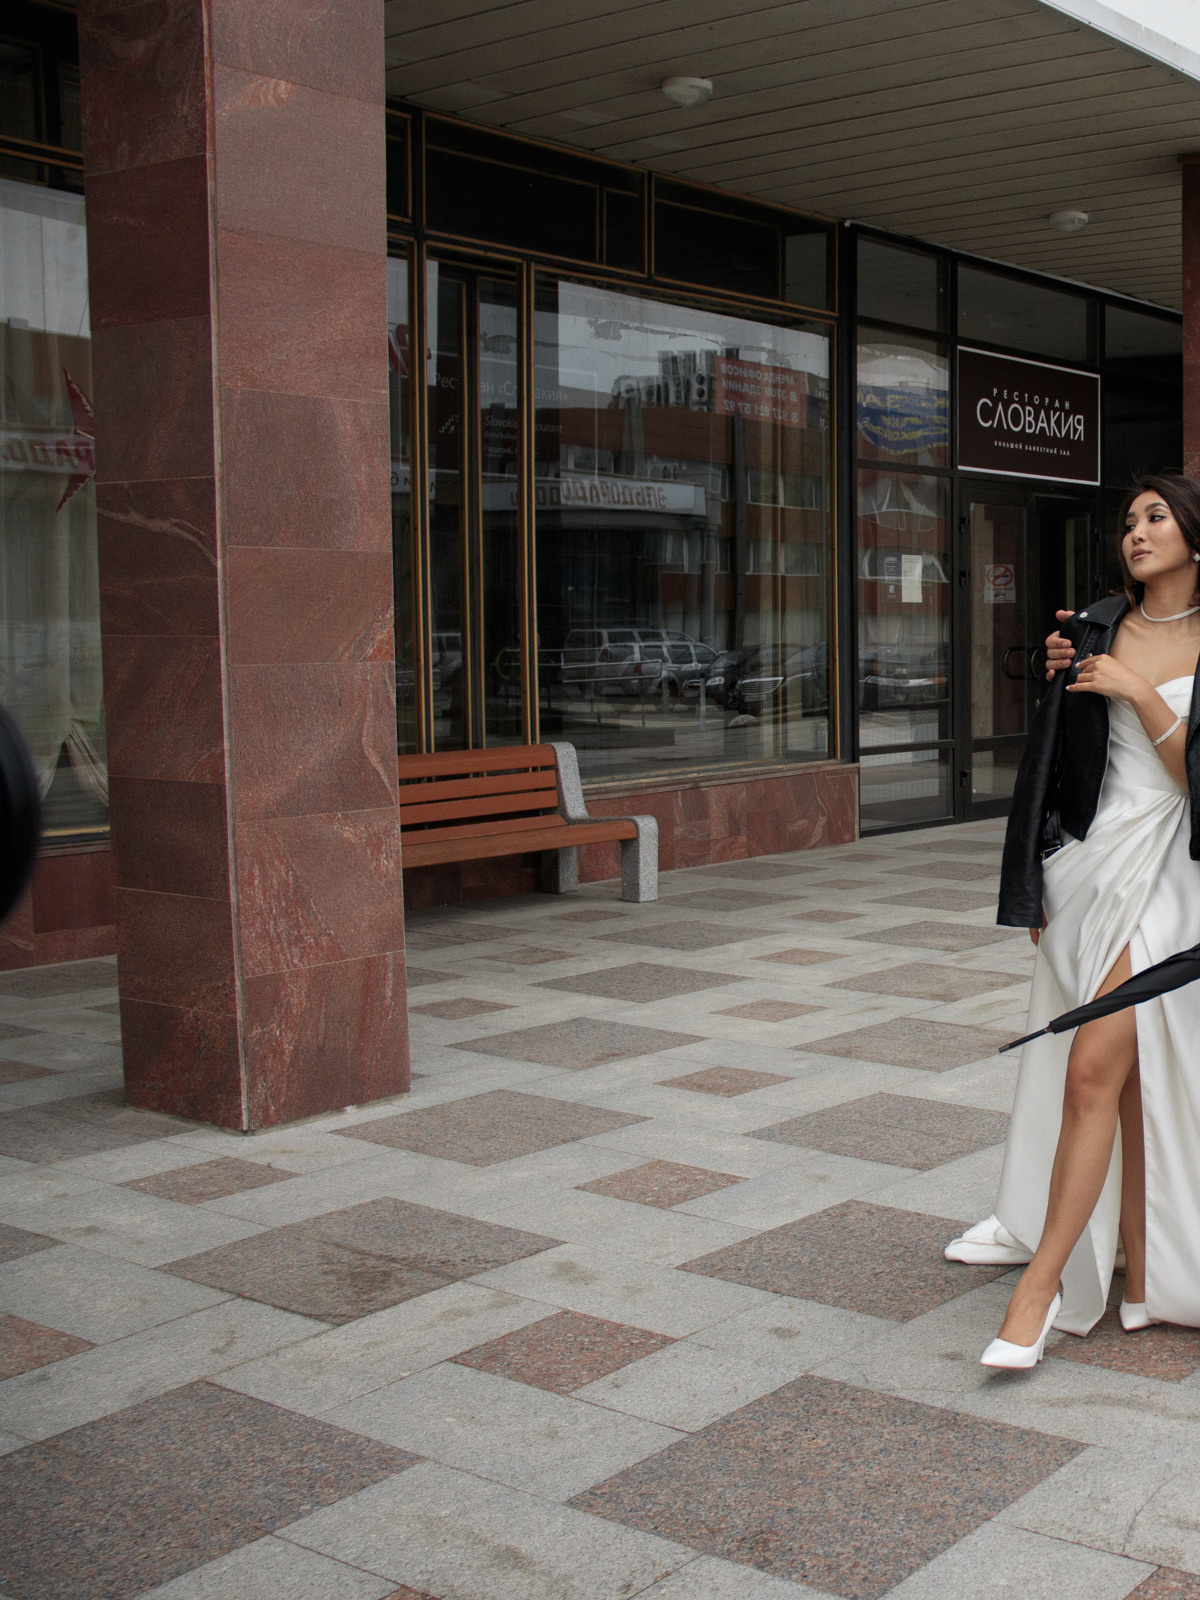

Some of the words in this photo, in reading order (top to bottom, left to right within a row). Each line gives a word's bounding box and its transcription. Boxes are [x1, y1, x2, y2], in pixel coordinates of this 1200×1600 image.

[993, 387, 1070, 410] РЕСТОРАН
[976, 398, 1084, 442] СЛОВАКИЯ
[994, 440, 1023, 450] БОЛЬШОЙ
[1025, 445, 1057, 455] БАНКЕТНЫЙ
